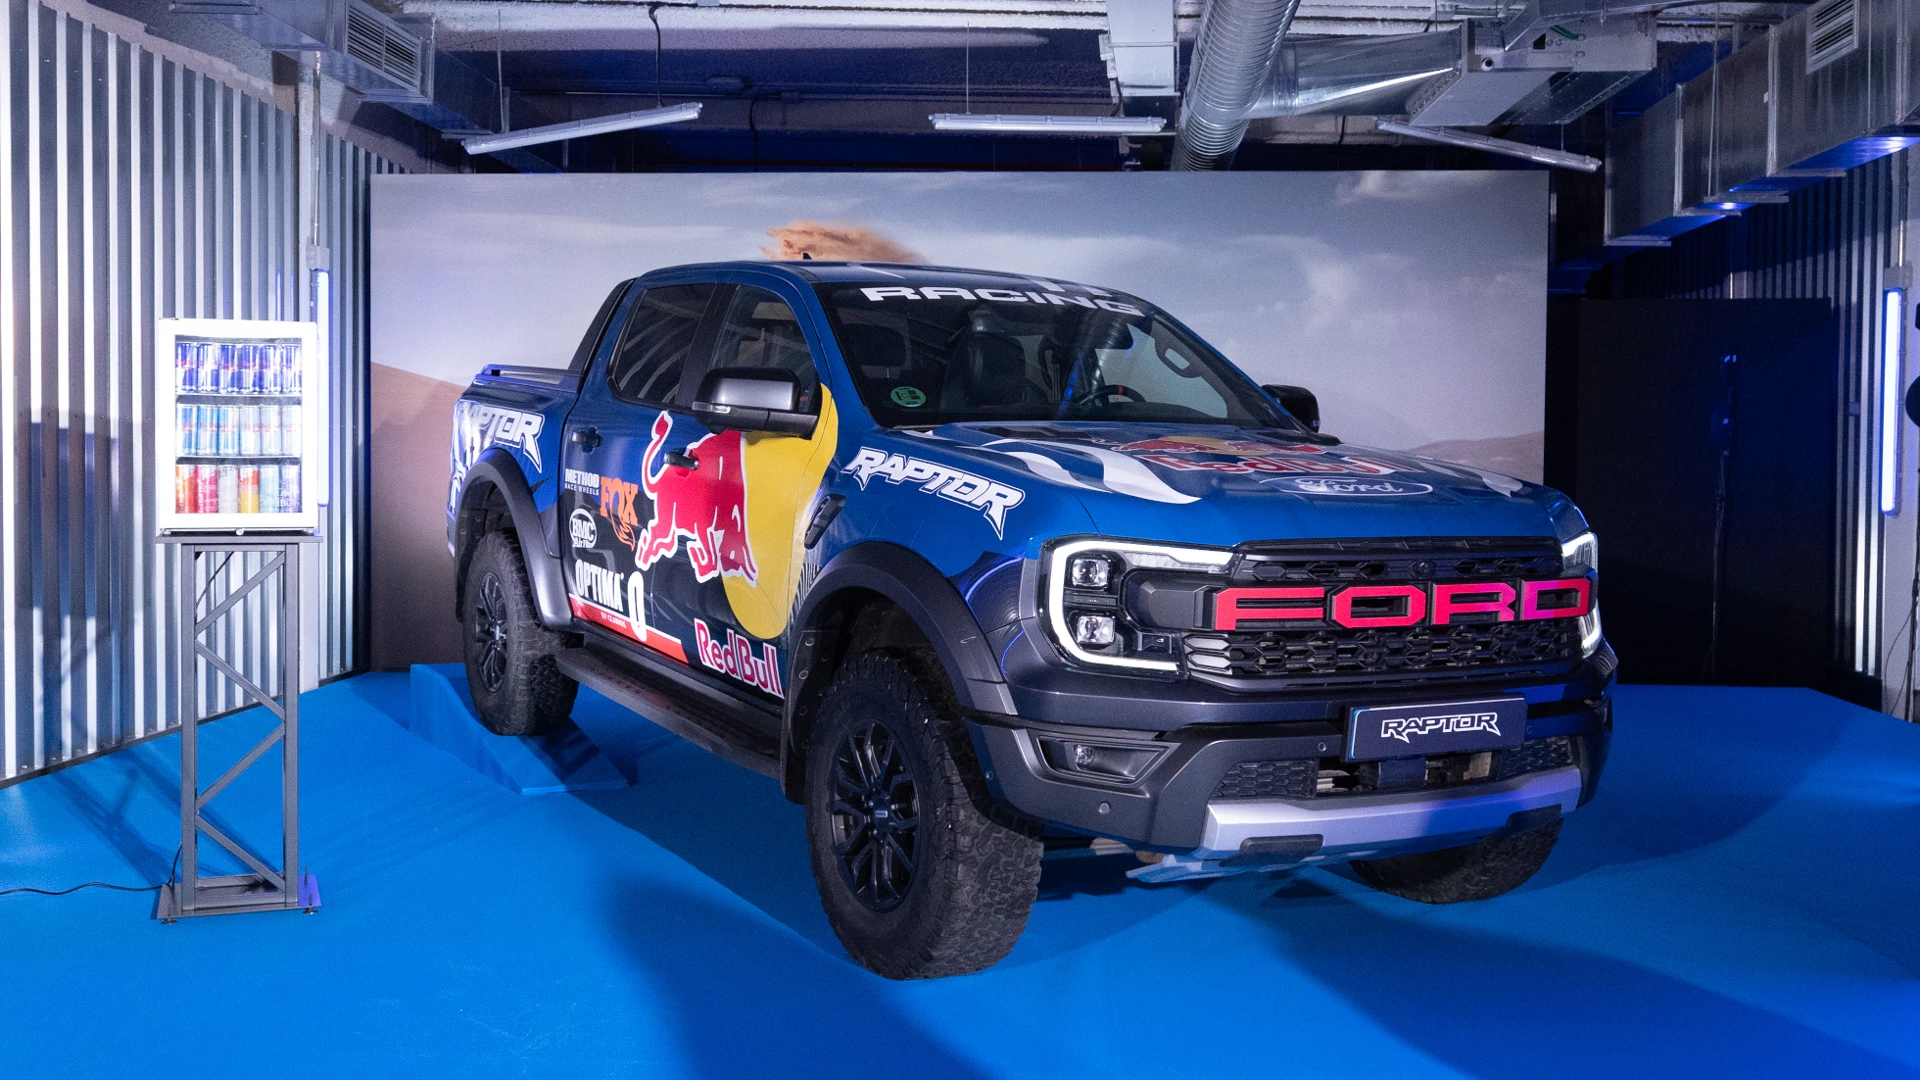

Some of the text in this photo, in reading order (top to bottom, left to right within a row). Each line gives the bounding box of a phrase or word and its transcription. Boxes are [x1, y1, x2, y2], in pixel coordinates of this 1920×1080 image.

[860, 286, 1145, 317] RACING
[463, 403, 546, 474] APTOR
[564, 482, 600, 496] RACE WHEELS
[565, 468, 600, 489] METHOD
[840, 446, 1026, 540] RAPTOR
[1295, 477, 1403, 493] Ford
[600, 476, 639, 531] FOX
[571, 518, 595, 542] BMC
[575, 559, 624, 613] OPTIMA
[1215, 577, 1590, 631] FORD
[1380, 712, 1502, 744] RAPTOR
